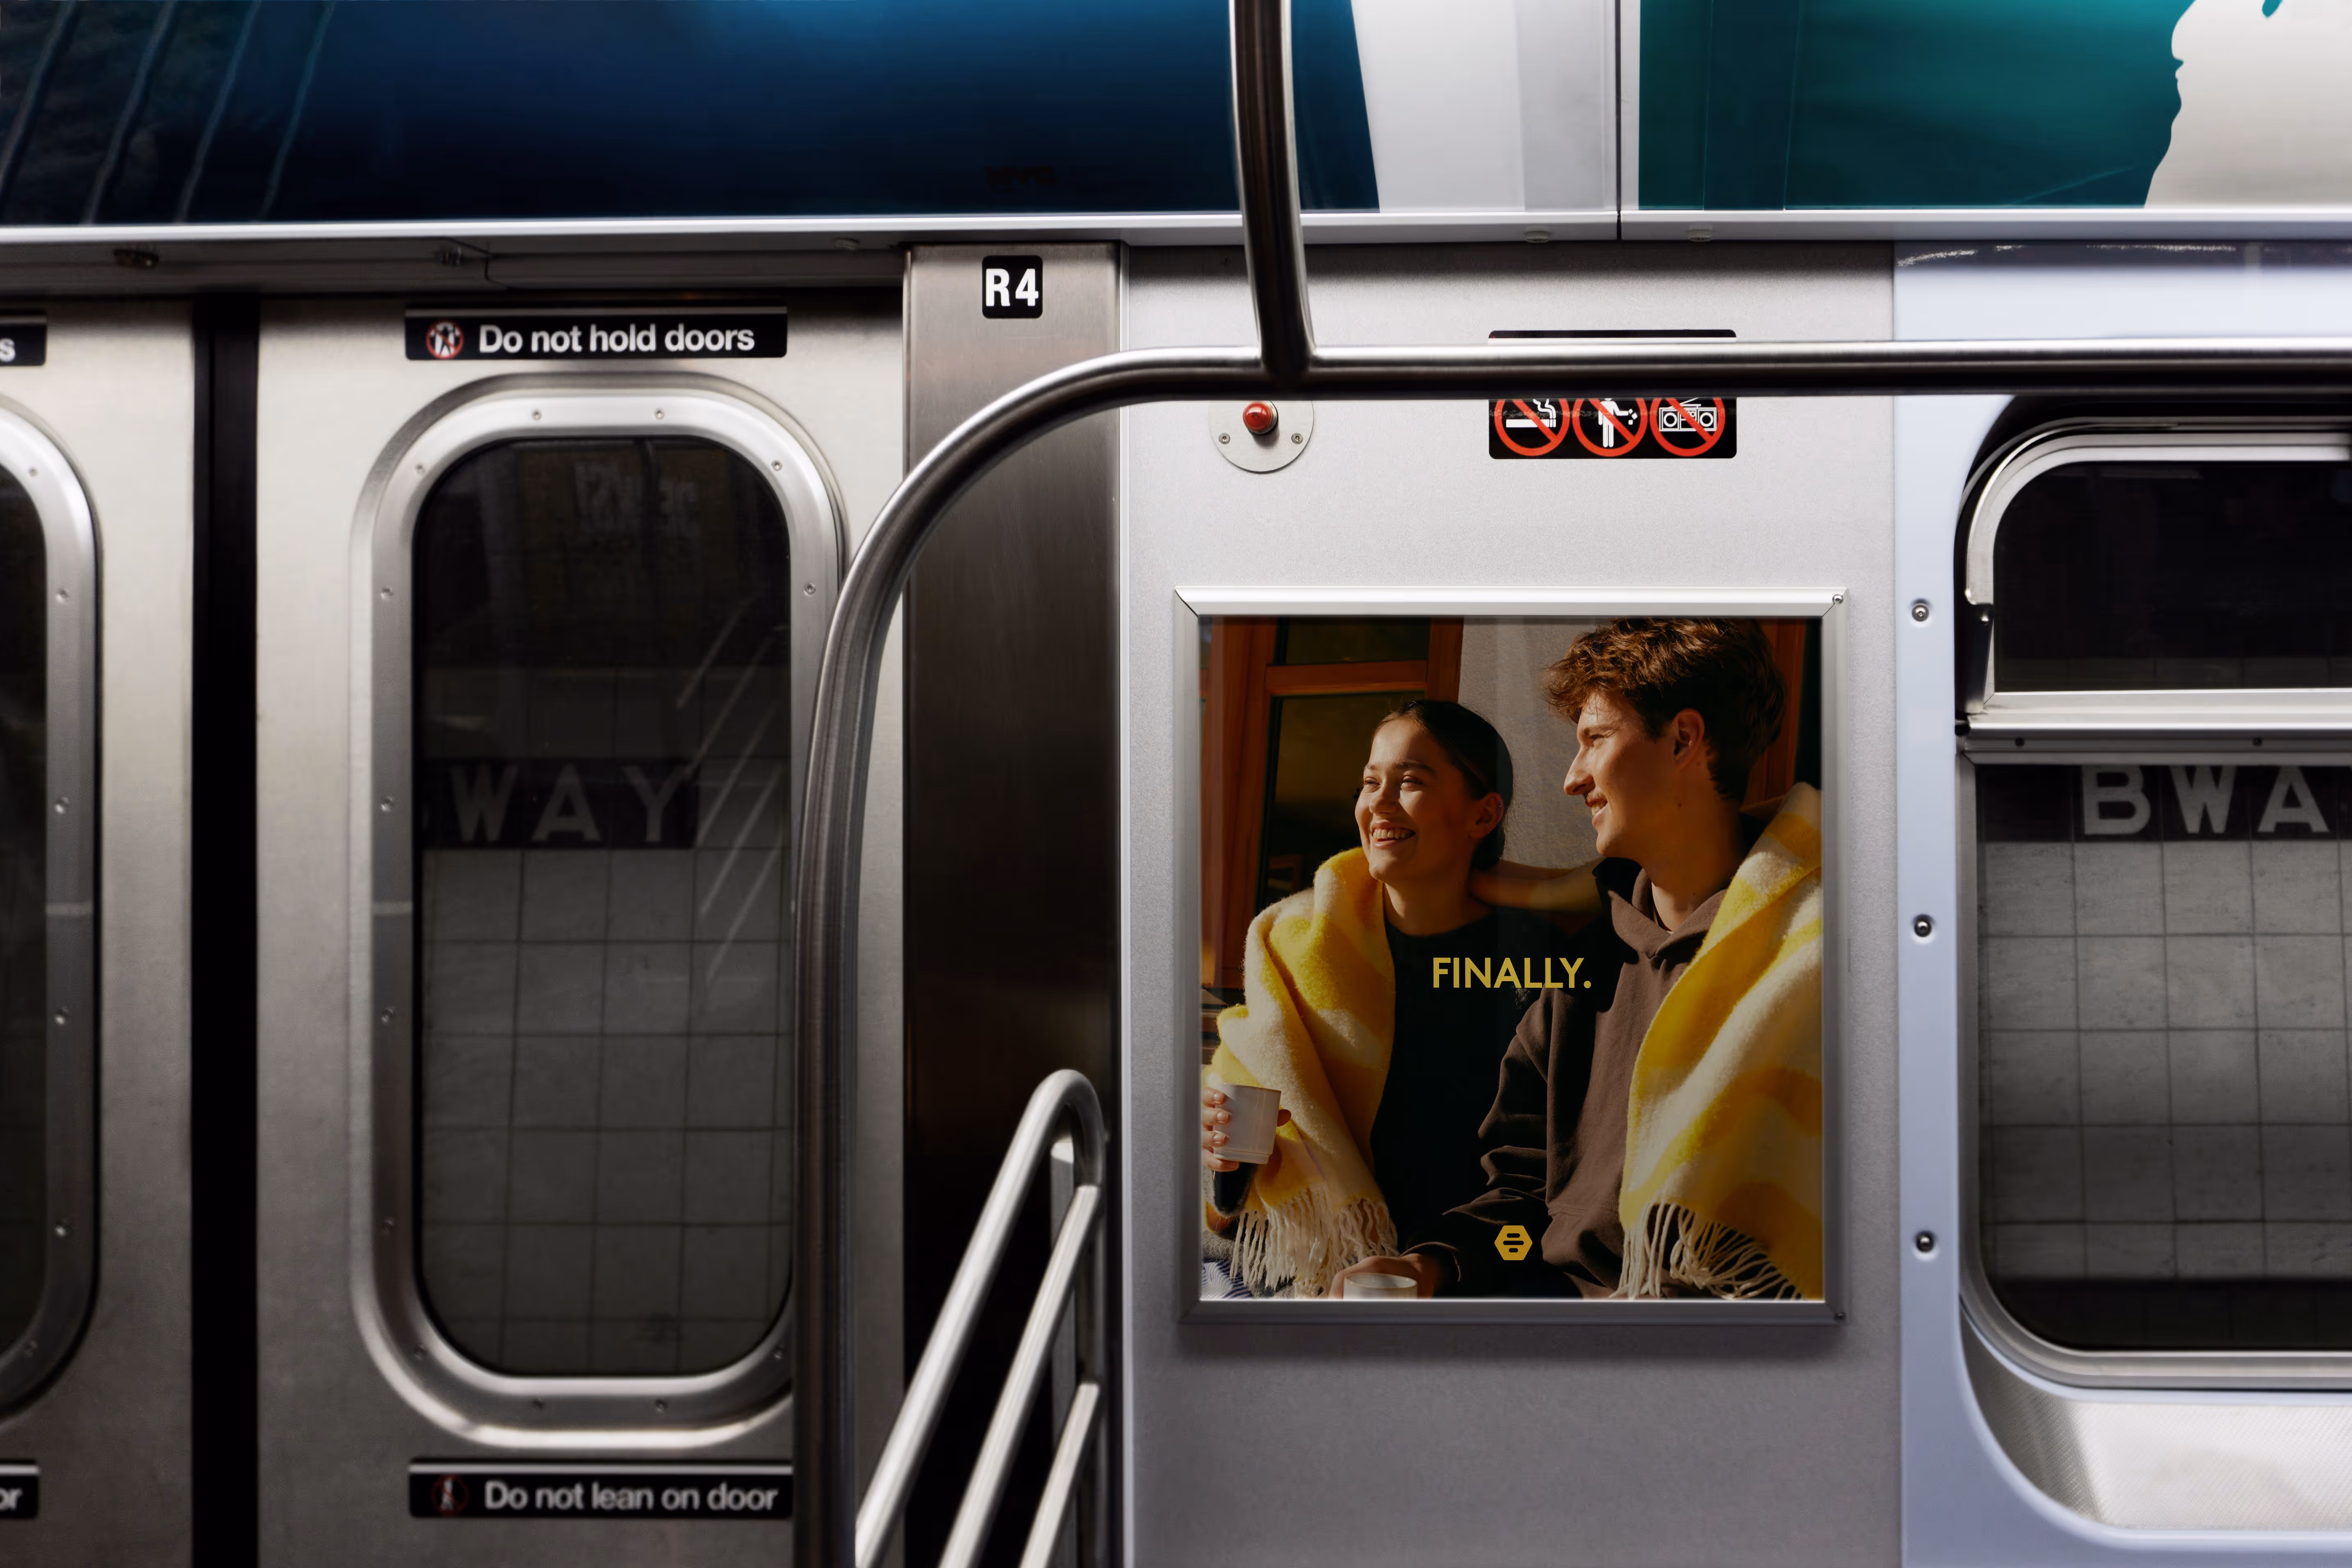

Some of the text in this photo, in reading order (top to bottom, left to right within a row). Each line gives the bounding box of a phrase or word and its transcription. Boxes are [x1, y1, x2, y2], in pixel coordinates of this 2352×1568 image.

[985, 268, 1039, 307] R4
[479, 324, 755, 353] Do not hold doors
[1433, 957, 1591, 989] FINALLY.
[485, 1481, 778, 1510] Do not lean on door
